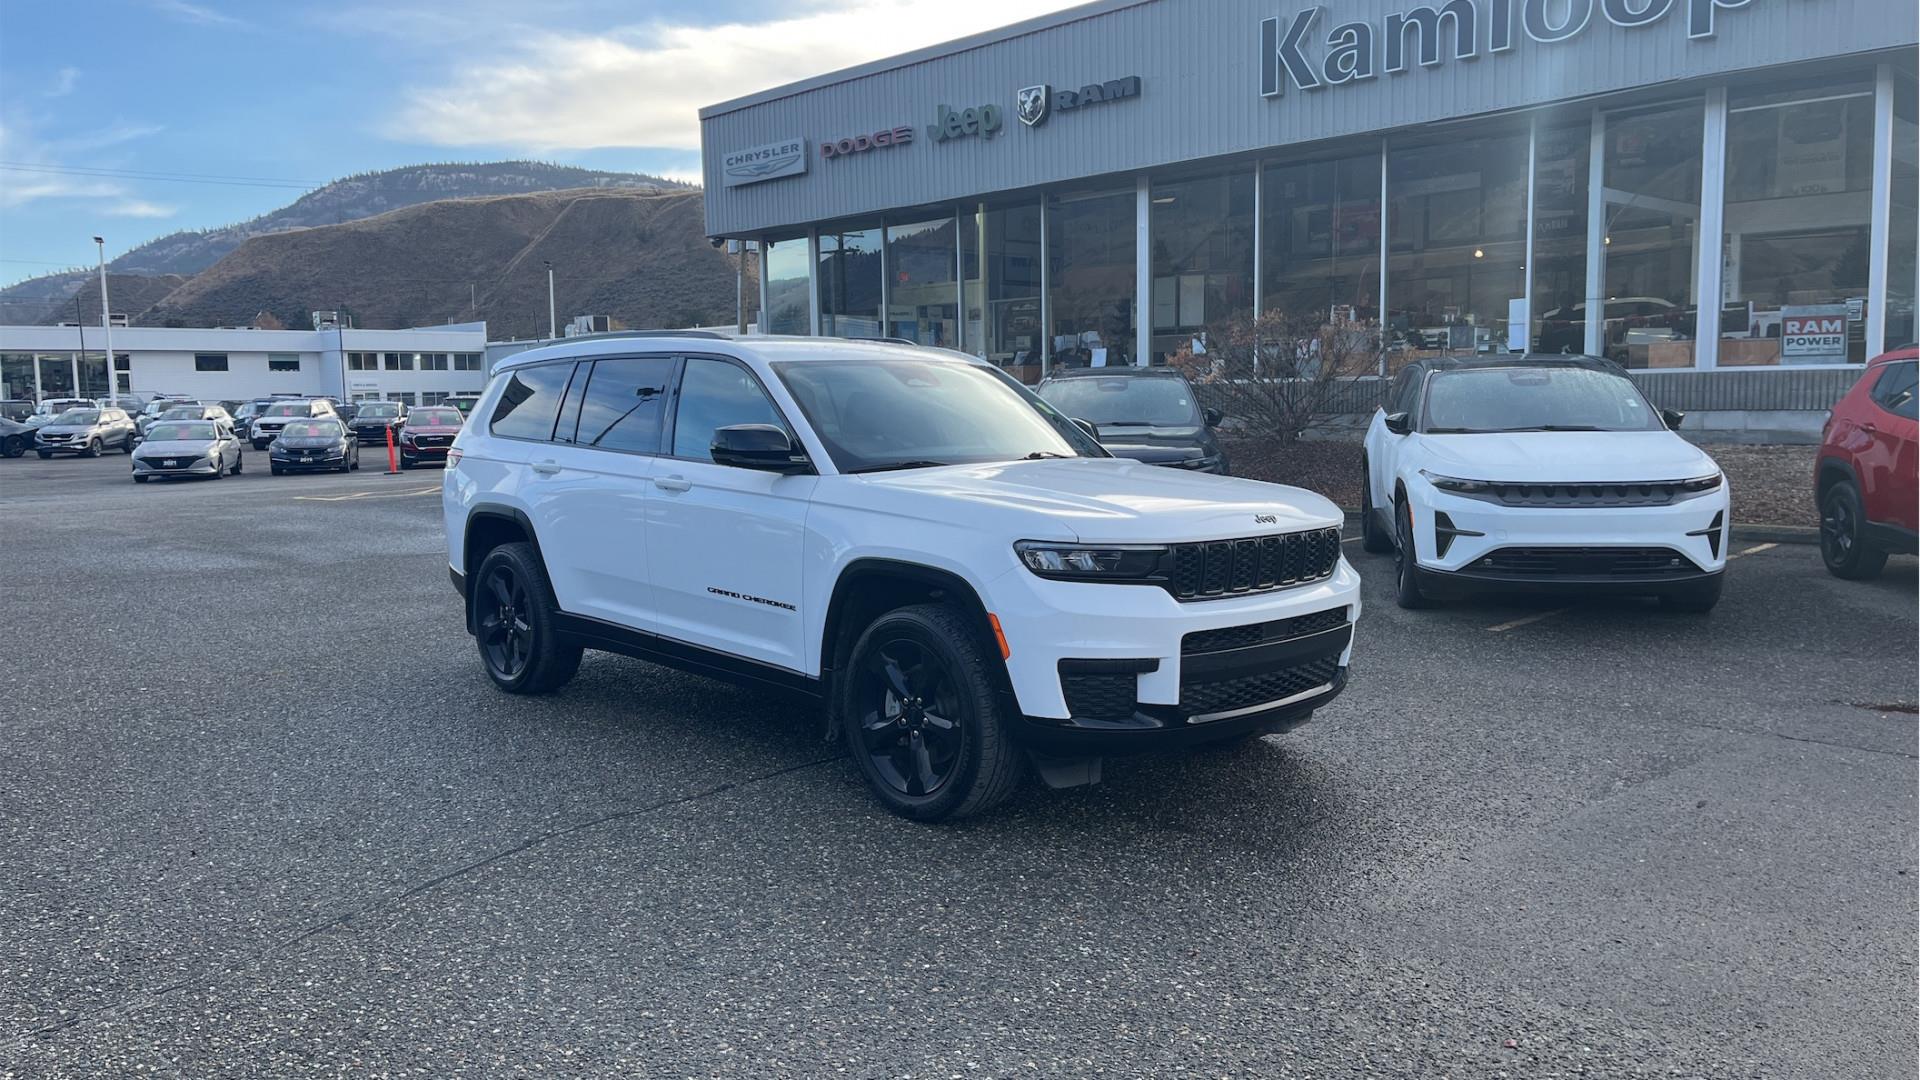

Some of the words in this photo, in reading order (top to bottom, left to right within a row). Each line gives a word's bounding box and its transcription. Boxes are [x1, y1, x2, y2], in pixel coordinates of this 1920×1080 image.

[1053, 76, 1140, 111] RAM
[927, 104, 1001, 140] Jeep
[820, 126, 912, 158] DODGE
[726, 143, 799, 166] CHRYSLER
[1786, 319, 1842, 334] RAM
[1786, 336, 1841, 346] POWER
[1255, 514, 1277, 524] Jeep
[707, 586, 740, 599] GRAND
[742, 594, 797, 612] CHEROKEE
